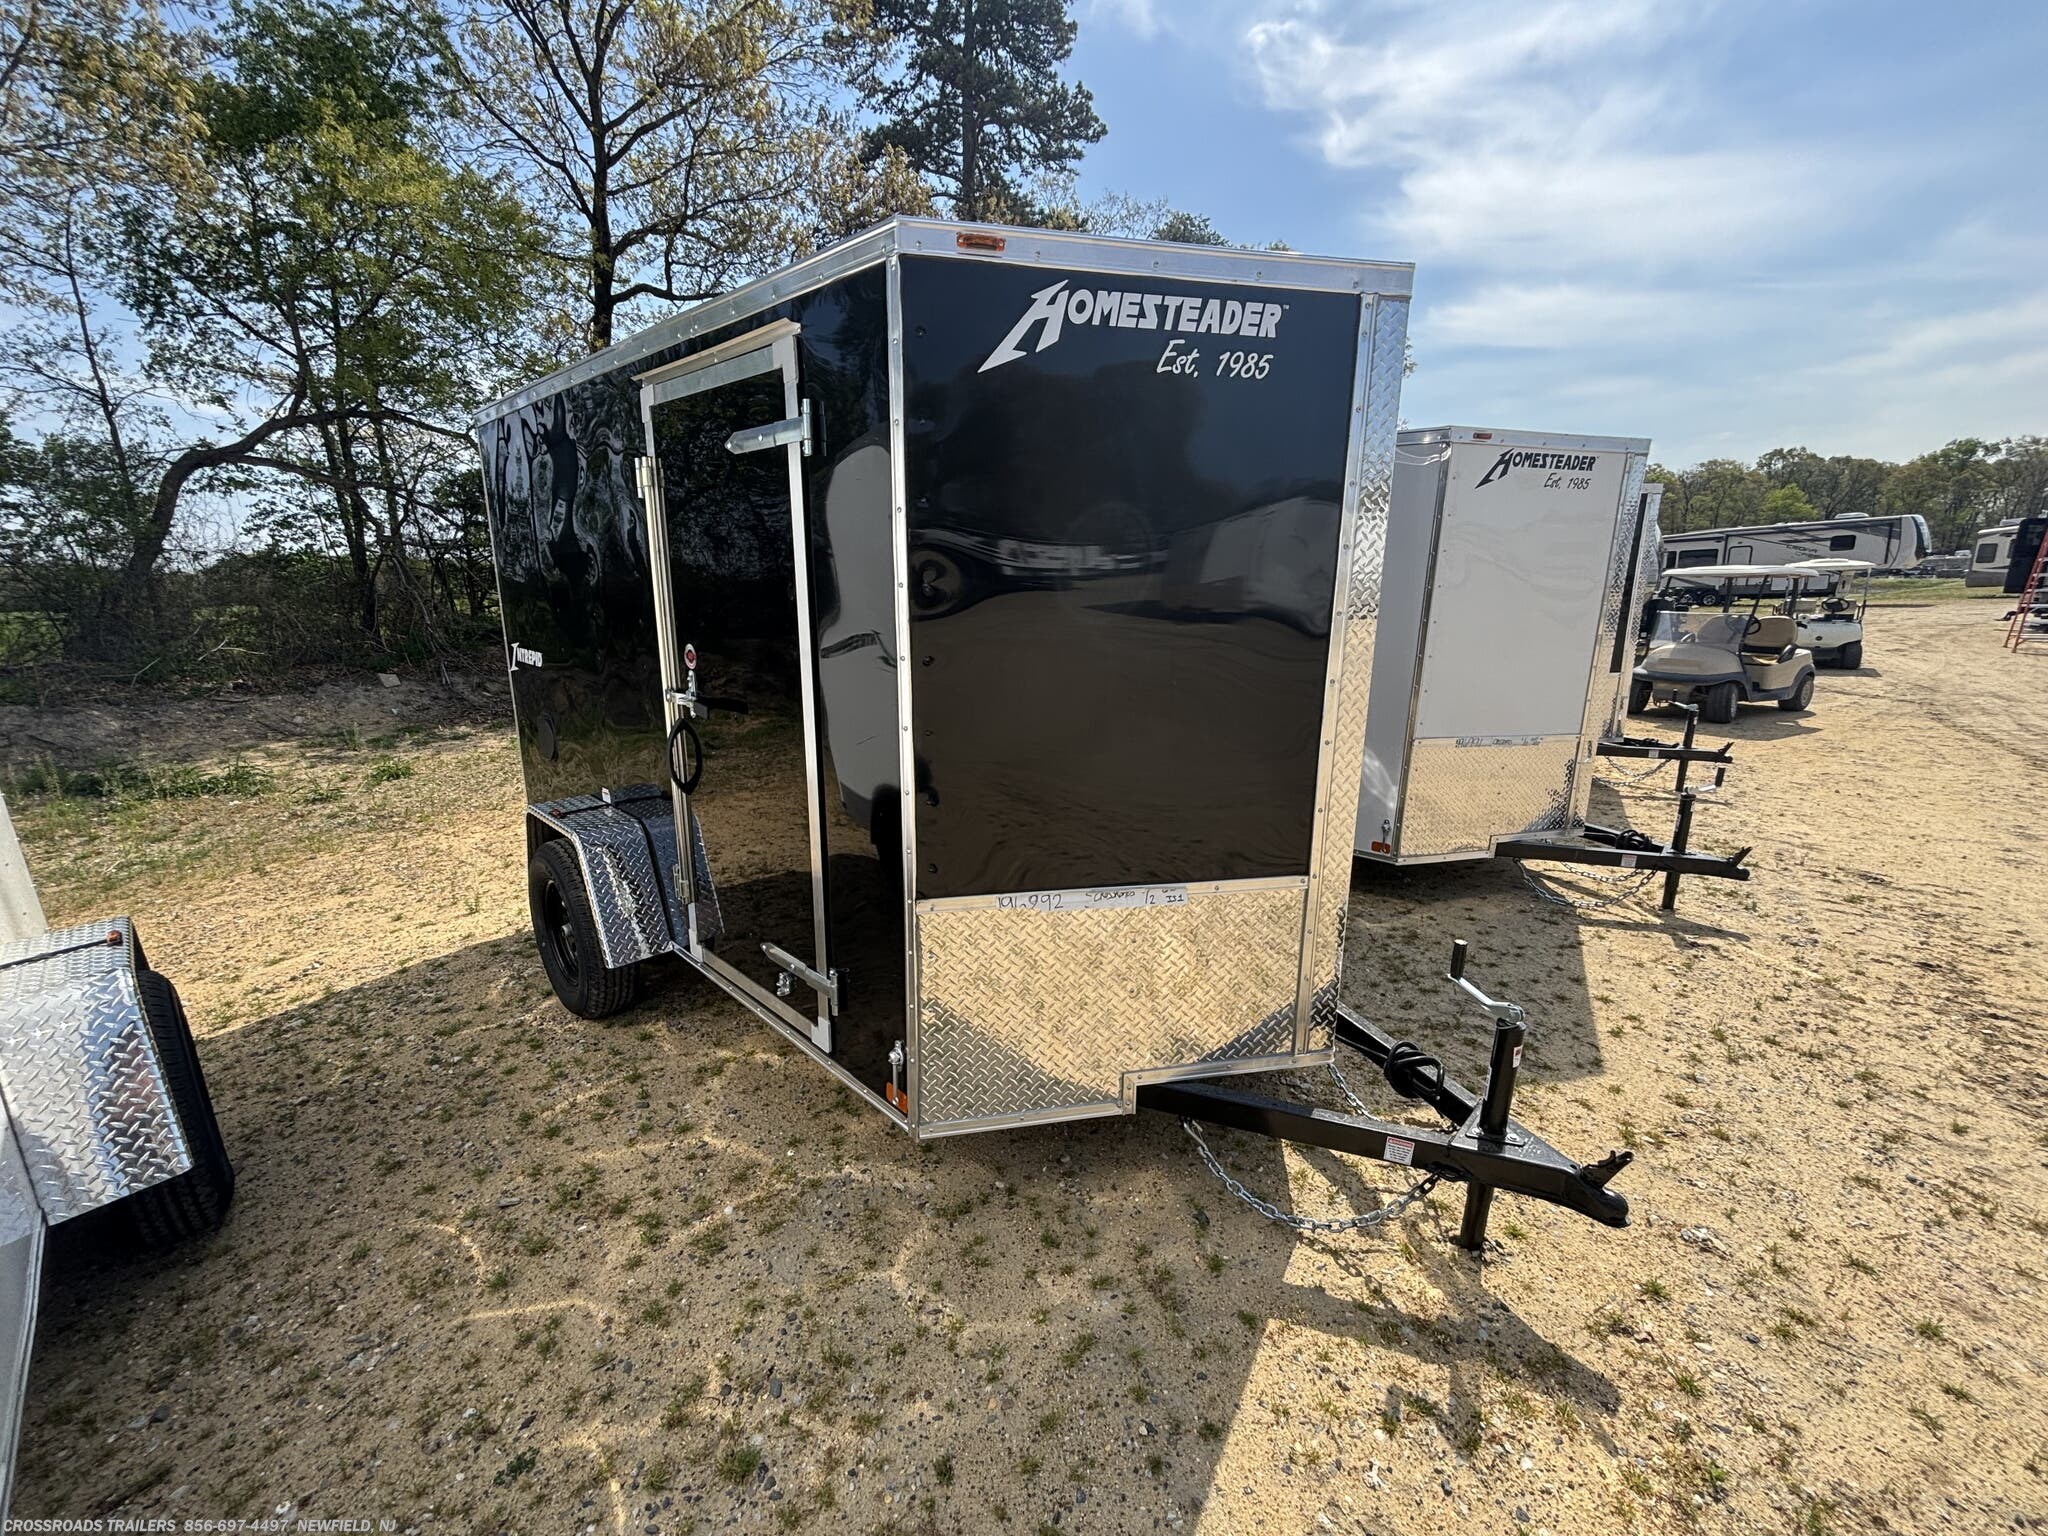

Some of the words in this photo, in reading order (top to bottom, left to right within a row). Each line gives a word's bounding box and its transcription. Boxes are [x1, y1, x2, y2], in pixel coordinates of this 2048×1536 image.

[977, 279, 1283, 373] HOMESTEADER
[1216, 351, 1274, 379] 1985
[1474, 448, 1597, 489] HOMESTEADER
[1566, 477, 1592, 490] 1985
[510, 642, 543, 671] INTREPID
